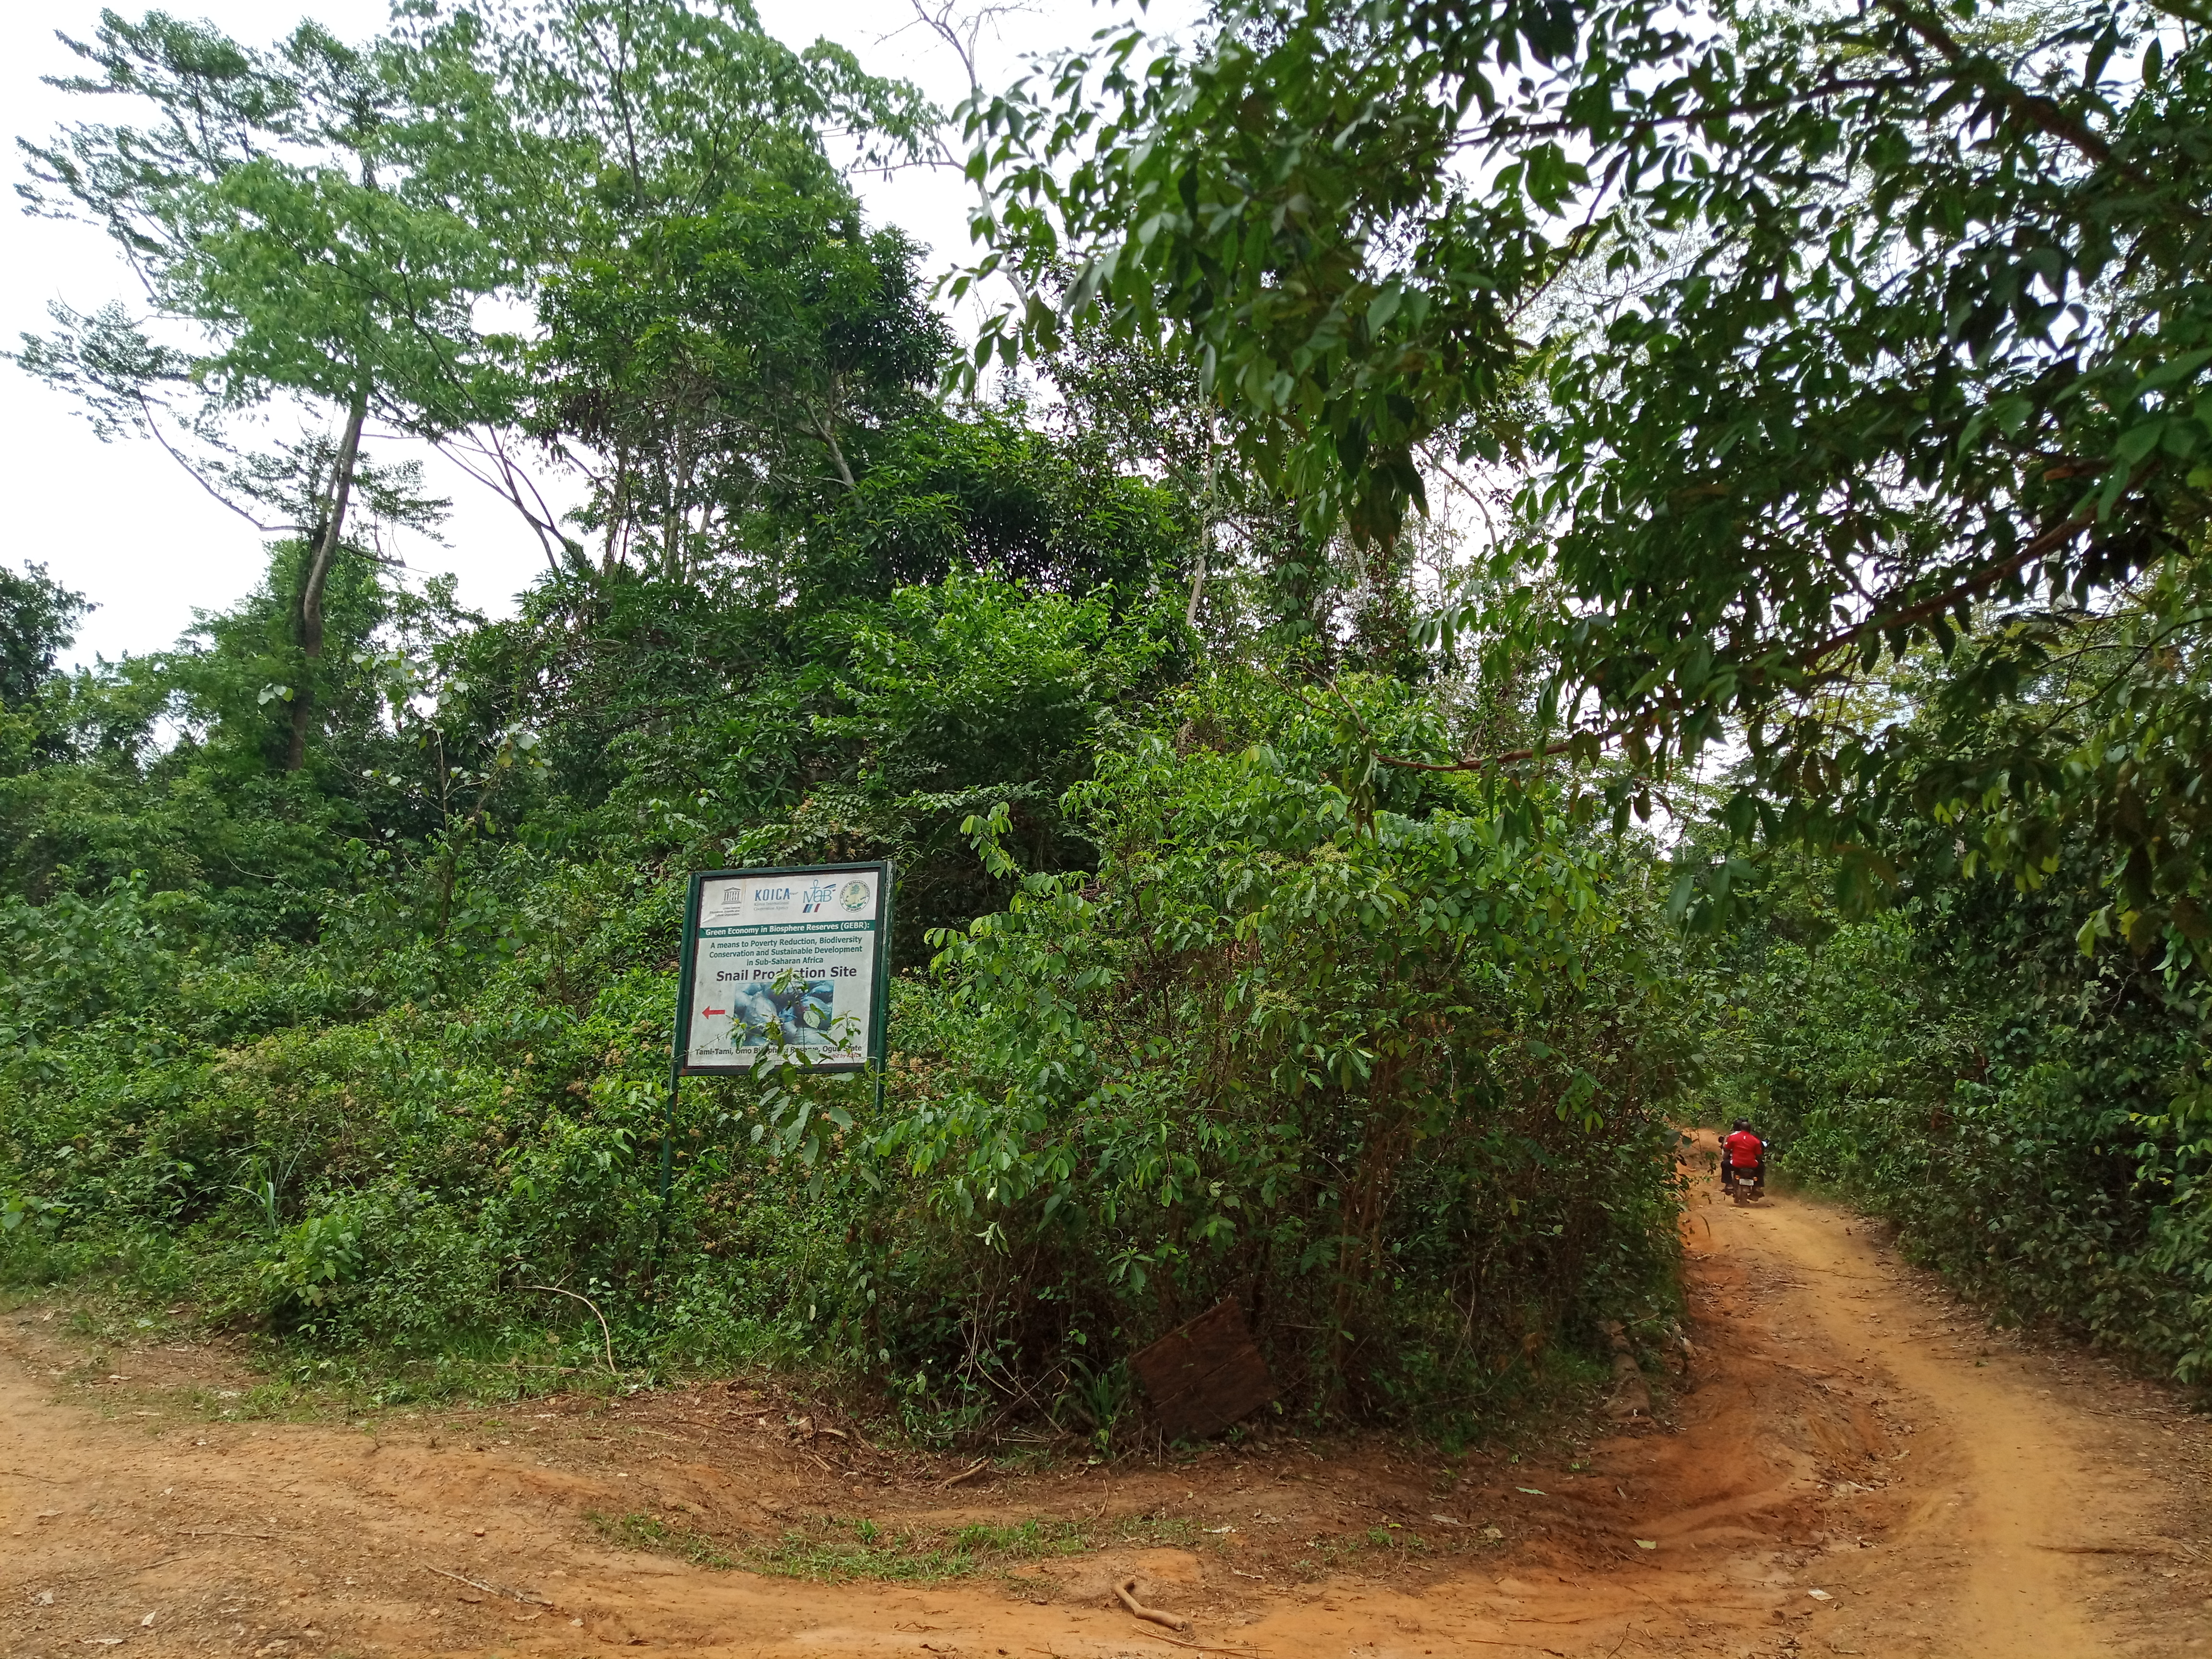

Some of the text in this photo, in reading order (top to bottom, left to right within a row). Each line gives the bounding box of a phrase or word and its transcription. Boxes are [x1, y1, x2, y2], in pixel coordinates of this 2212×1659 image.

[755, 888, 790, 902] KOICA
[769, 925, 805, 933] Biosphere
[841, 922, 870, 930] (GEBR):
[780, 938, 817, 946] Reduction,
[819, 936, 862, 944] Biodiversity
[709, 950, 754, 958] Conservation
[771, 947, 812, 955] Sustainable
[815, 946, 863, 954] Development
[755, 957, 801, 965] Sub-Saharan
[716, 966, 857, 982] Snail Prodtion Site
